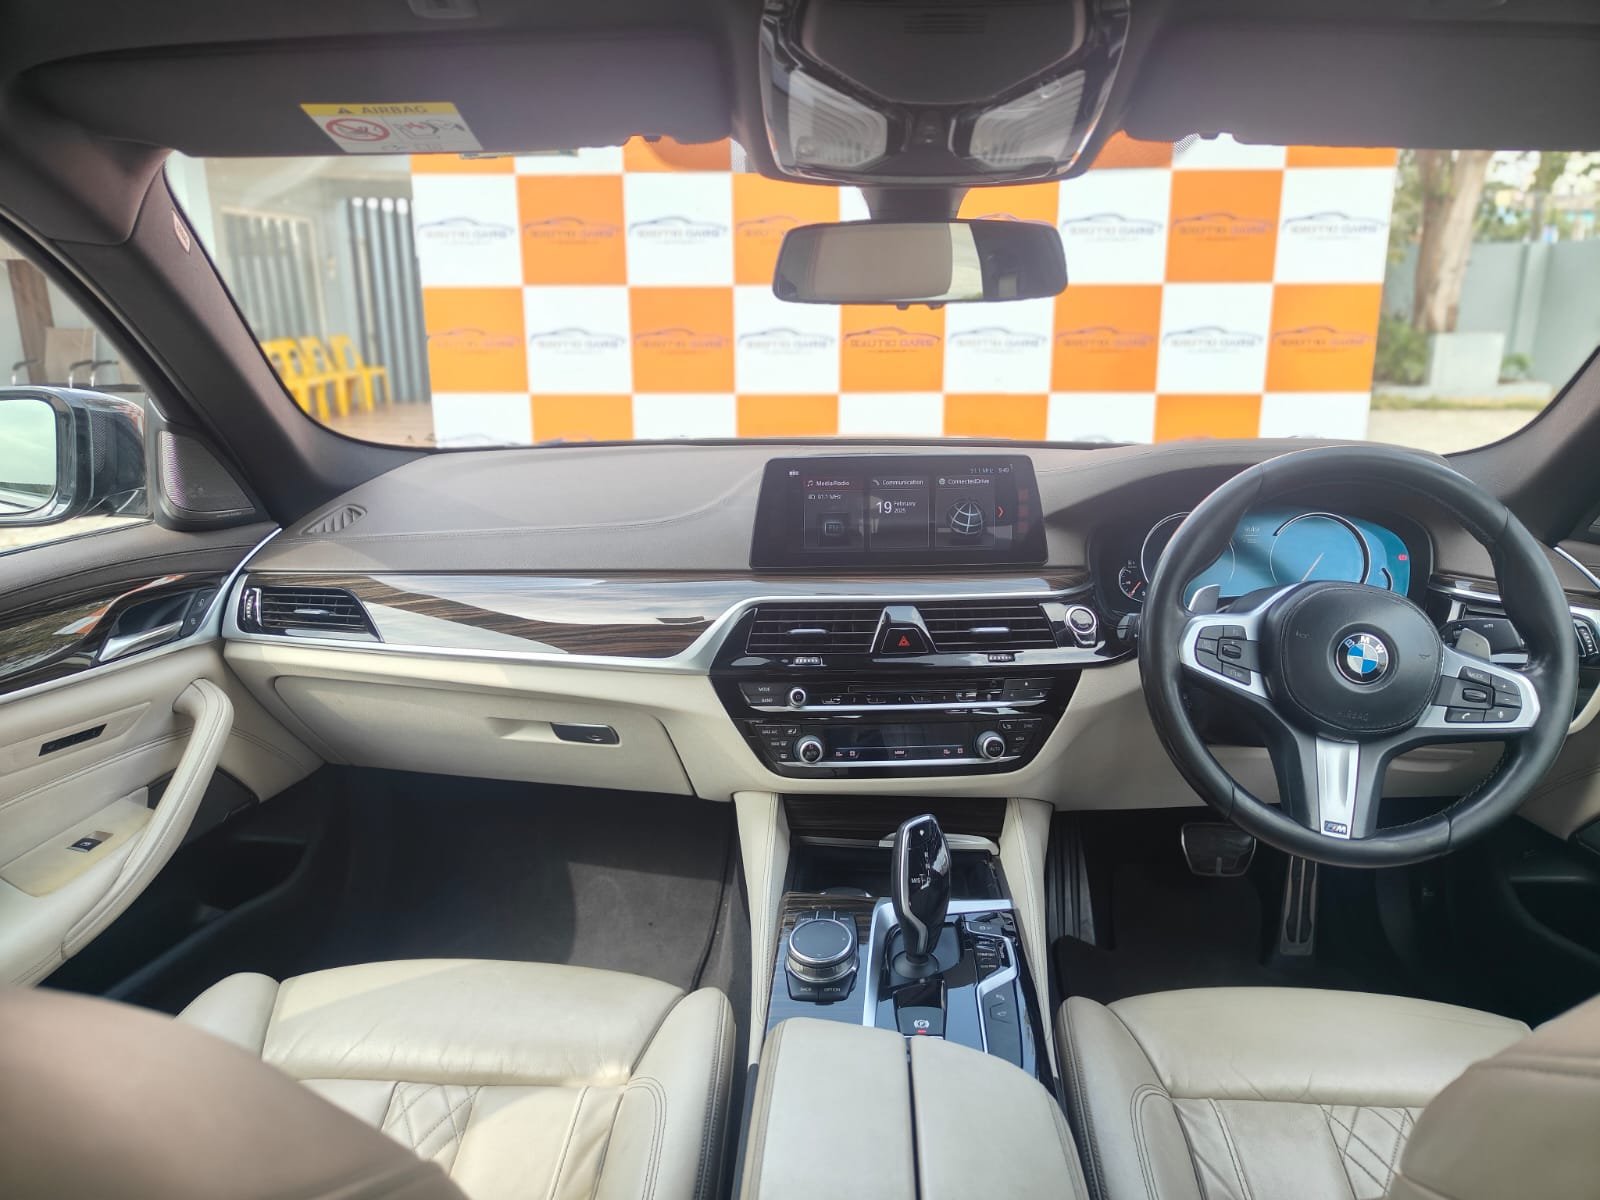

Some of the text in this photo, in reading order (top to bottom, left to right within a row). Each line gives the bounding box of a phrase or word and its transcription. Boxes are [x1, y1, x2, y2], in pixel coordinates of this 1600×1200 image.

[361, 105, 428, 114] AIRBAG
[875, 500, 893, 514] 19
[1344, 635, 1386, 654] BMW
